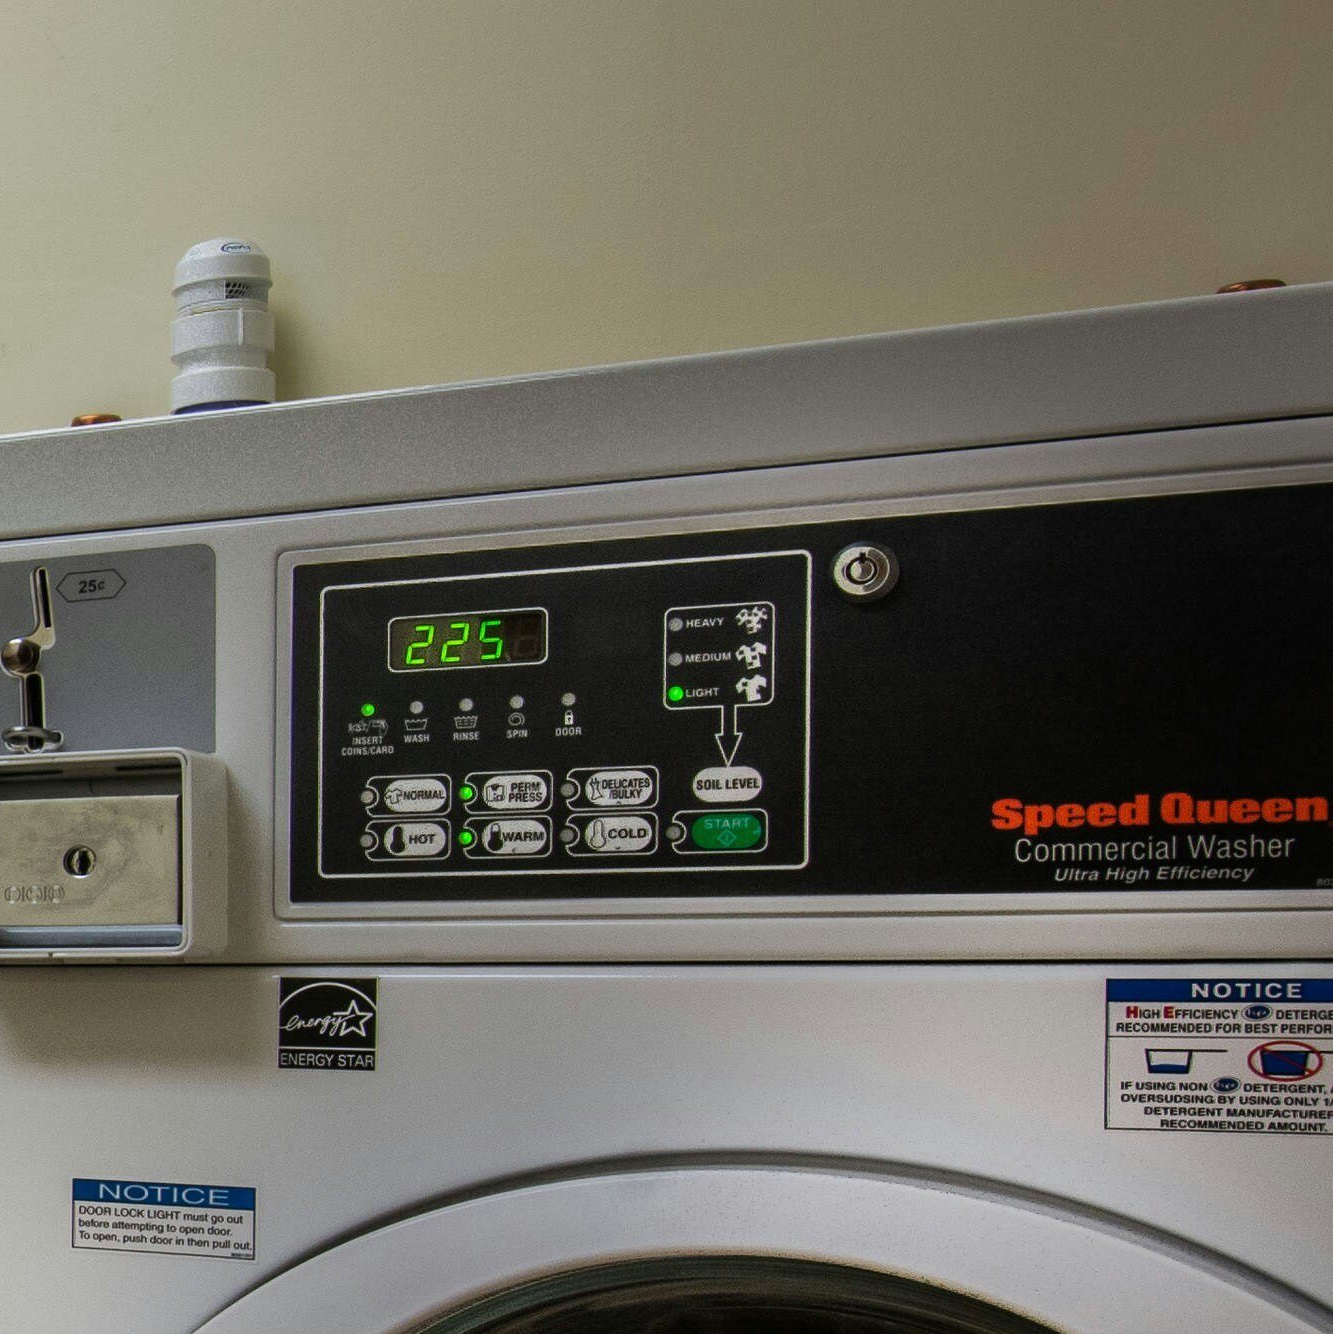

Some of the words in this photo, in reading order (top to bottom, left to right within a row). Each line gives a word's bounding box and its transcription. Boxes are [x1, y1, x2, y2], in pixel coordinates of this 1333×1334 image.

[685, 618, 724, 628] HEAVY
[405, 620, 503, 664] 225
[685, 652, 731, 662] MEDIUM
[685, 688, 719, 698] LIGHT
[453, 731, 480, 741] RINSE
[507, 729, 528, 739] SPIN
[555, 726, 582, 736] DOOR
[352, 736, 383, 746] INSERT
[403, 734, 429, 743] WASH
[511, 782, 541, 792] PERM
[601, 778, 650, 789] DELICATES
[696, 779, 721, 790] SOIL
[725, 777, 759, 789] LEVEL
[403, 790, 445, 800] NORMAL
[508, 792, 543, 802] PRESS
[991, 793, 1150, 836] Speed
[1160, 792, 1329, 825] Queen
[703, 817, 751, 829] START
[409, 834, 436, 844] HOT
[503, 832, 544, 842] WARM
[608, 828, 647, 839] COLD
[1015, 836, 1177, 862] Commercial
[1188, 835, 1295, 860] Washer
[1054, 868, 1099, 882] Ultra
[1106, 868, 1149, 884] High
[1157, 866, 1254, 883] Efficiency
[1191, 982, 1302, 999] NOTICE
[285, 1014, 345, 1036] energy
[1116, 1022, 1212, 1034] RECOMMENDED
[1215, 1023, 1241, 1034] FOR
[1245, 1023, 1277, 1034] BEST
[281, 1052, 333, 1066] ENERGY
[338, 1054, 374, 1068] STAR
[1121, 1081, 1133, 1090] IF
[1135, 1081, 1175, 1091] USING
[1179, 1082, 1207, 1092] NON
[1243, 1082, 1327, 1094] DETERGENT,
[1121, 1094, 1214, 1104] OVERSUDSING
[1218, 1096, 1235, 1106] BY
[1239, 1096, 1281, 1106] USING
[1284, 1096, 1319, 1106] ONLY
[1144, 1106, 1223, 1116] DETERGENT
[1161, 1119, 1265, 1130] RECOMMENDED
[1267, 1121, 1329, 1132] AMOUNT.
[99, 1183, 229, 1206] NOTICE
[79, 1205, 111, 1216] DOOR
[115, 1208, 145, 1218] LOCK
[147, 1210, 181, 1220] LIGHT
[183, 1212, 209, 1222] must
[211, 1216, 224, 1225] go
[227, 1215, 243, 1224] out
[79, 1218, 109, 1228] before
[112, 1221, 164, 1233] attempting
[167, 1224, 177, 1232] to
[179, 1225, 205, 1236] open
[207, 1226, 233, 1236] door.
[79, 1230, 91, 1240] To
[123, 1234, 147, 1244] push
[150, 1236, 173, 1245] door
[175, 1236, 185, 1246] in
[187, 1238, 209, 1248] then
[212, 1240, 231, 1250] pull
[233, 1242, 253, 1250] out.
